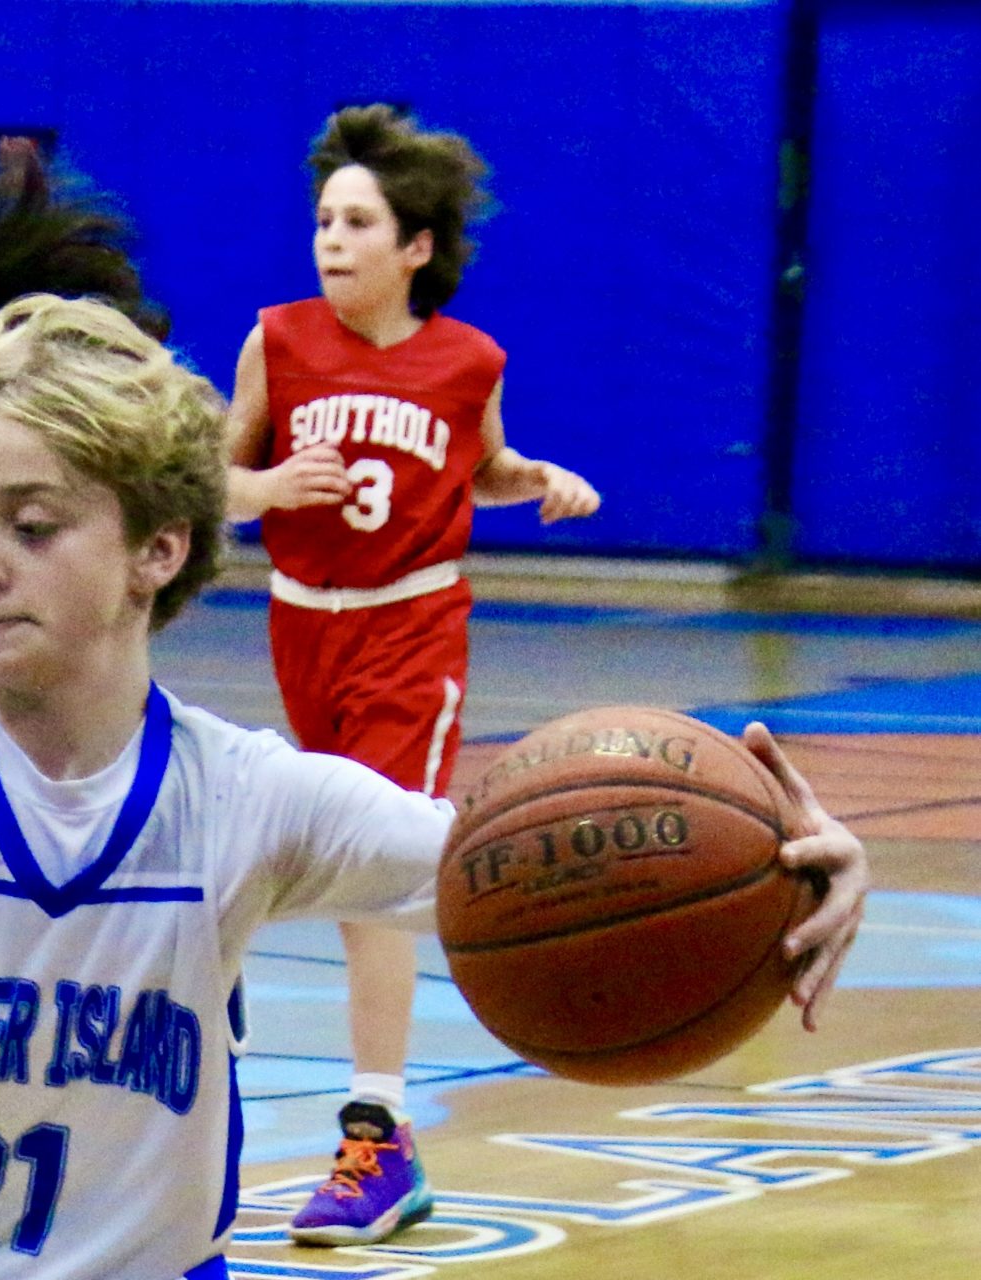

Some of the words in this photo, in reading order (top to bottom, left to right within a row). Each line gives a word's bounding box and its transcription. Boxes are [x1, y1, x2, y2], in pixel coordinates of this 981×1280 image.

[289, 393, 451, 472] SOUTHOLD
[341, 458, 395, 533] 3
[44, 978, 203, 1117] ISLAND
